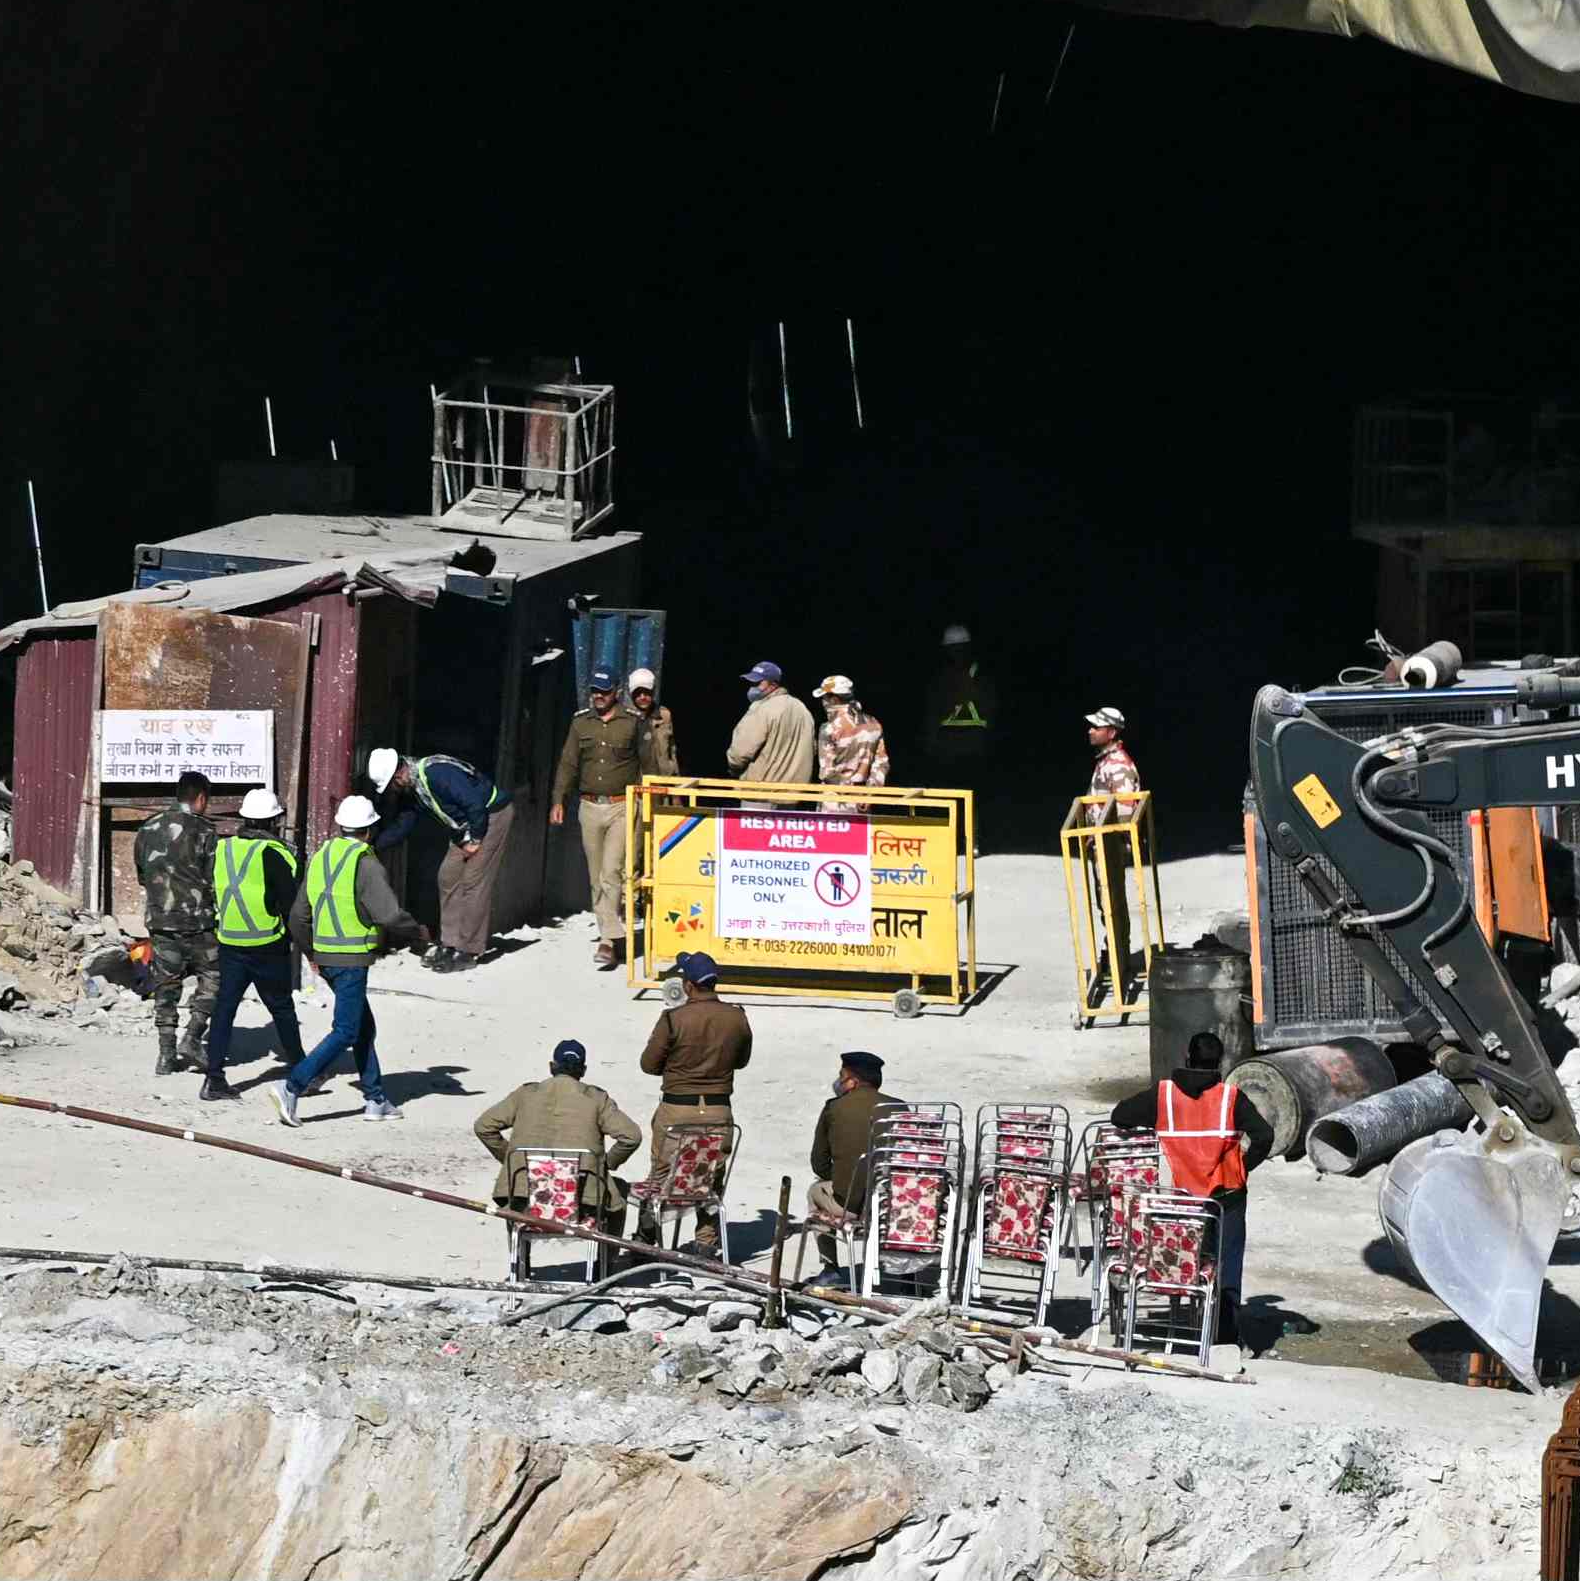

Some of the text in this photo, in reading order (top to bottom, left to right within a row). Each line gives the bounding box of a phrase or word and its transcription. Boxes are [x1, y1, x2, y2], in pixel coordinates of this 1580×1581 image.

[134, 738, 163, 756] नियम
[167, 738, 182, 756] जो
[212, 743, 245, 757] सफल
[139, 759, 161, 777] कभी
[164, 764, 175, 777] न
[739, 815, 851, 832] RESTRICTED
[768, 834, 817, 849] AREA
[871, 830, 927, 858] लिस
[730, 858, 811, 871] AUTHORIZED
[731, 874, 808, 888] PERSONNEL
[753, 892, 786, 904] ONLY
[755, 915, 767, 930] से
[834, 919, 866, 936] पुलिस
